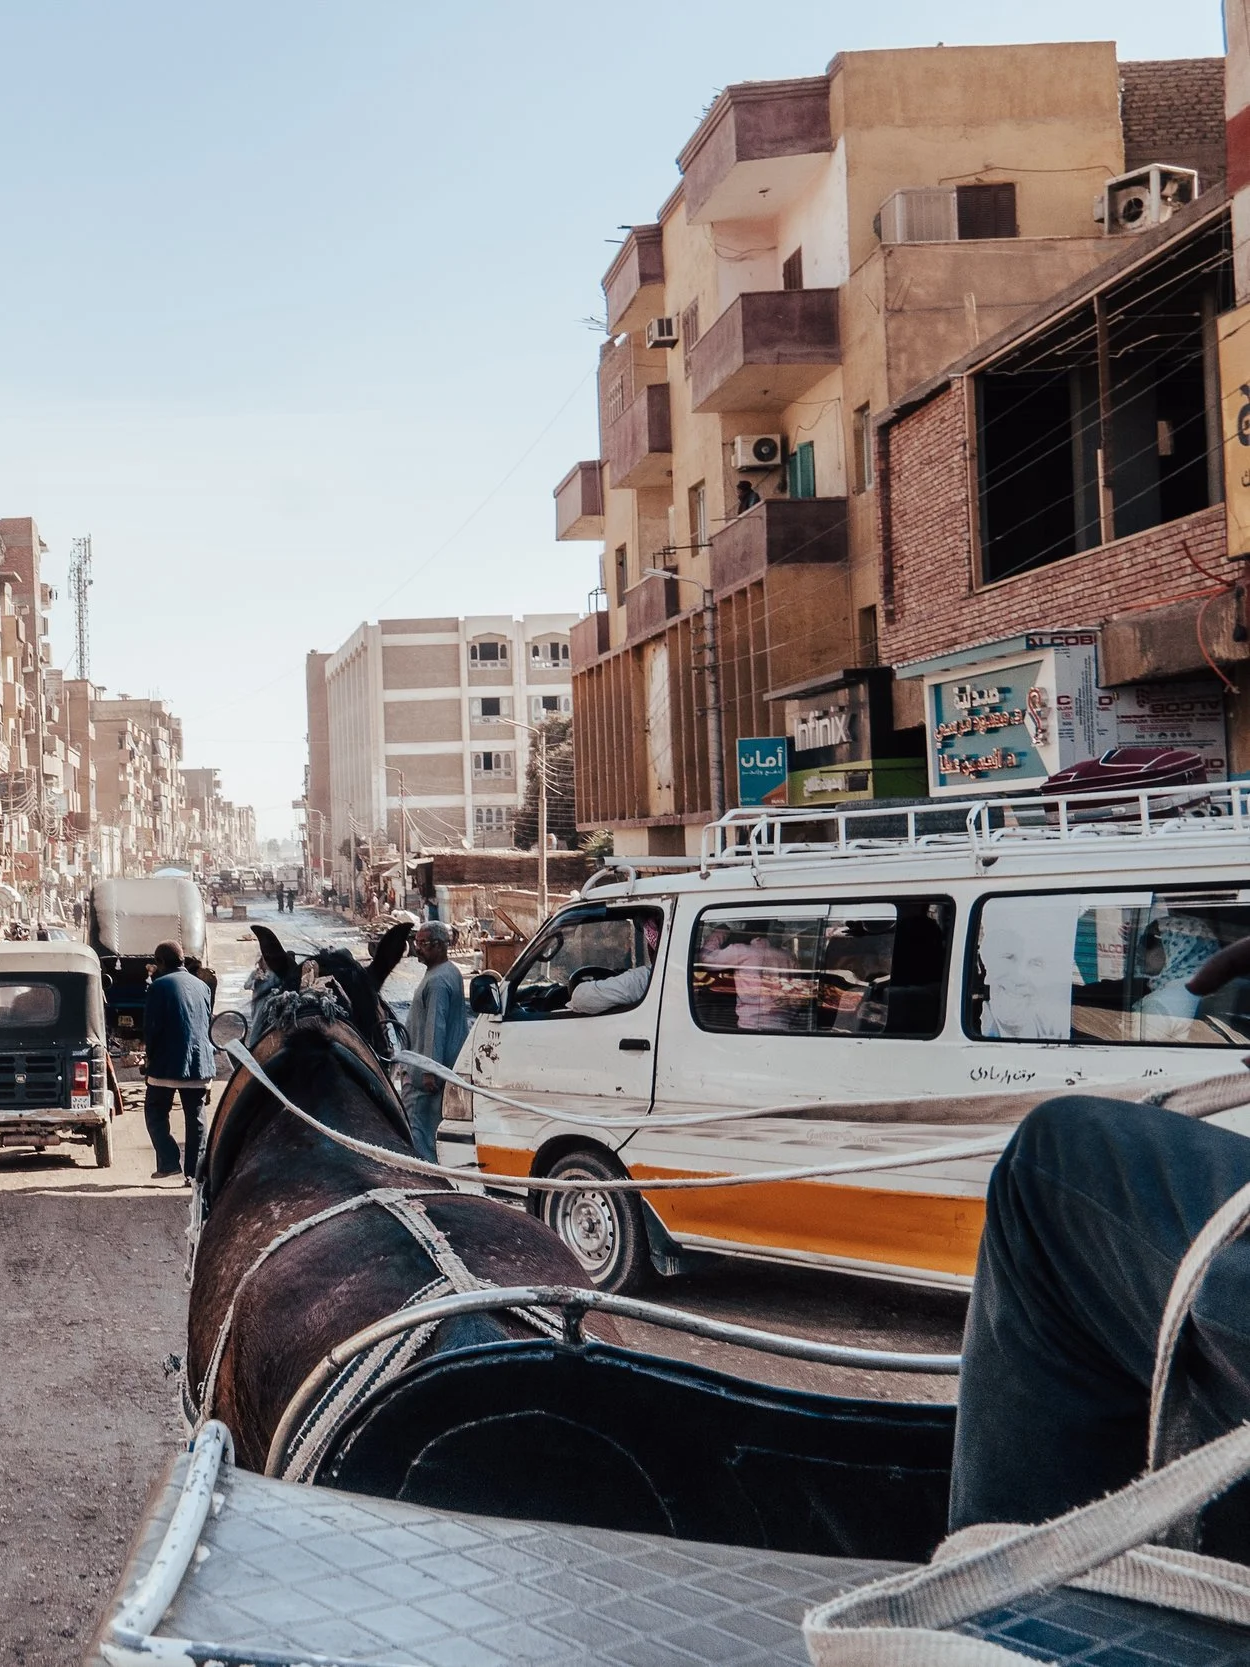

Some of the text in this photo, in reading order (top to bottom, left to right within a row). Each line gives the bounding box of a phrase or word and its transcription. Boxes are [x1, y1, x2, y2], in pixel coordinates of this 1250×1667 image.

[1029, 634, 1097, 647] ALCOB
[952, 684, 1000, 717] صيدلية
[794, 706, 851, 752] Infinix
[741, 746, 784, 768] أمان
